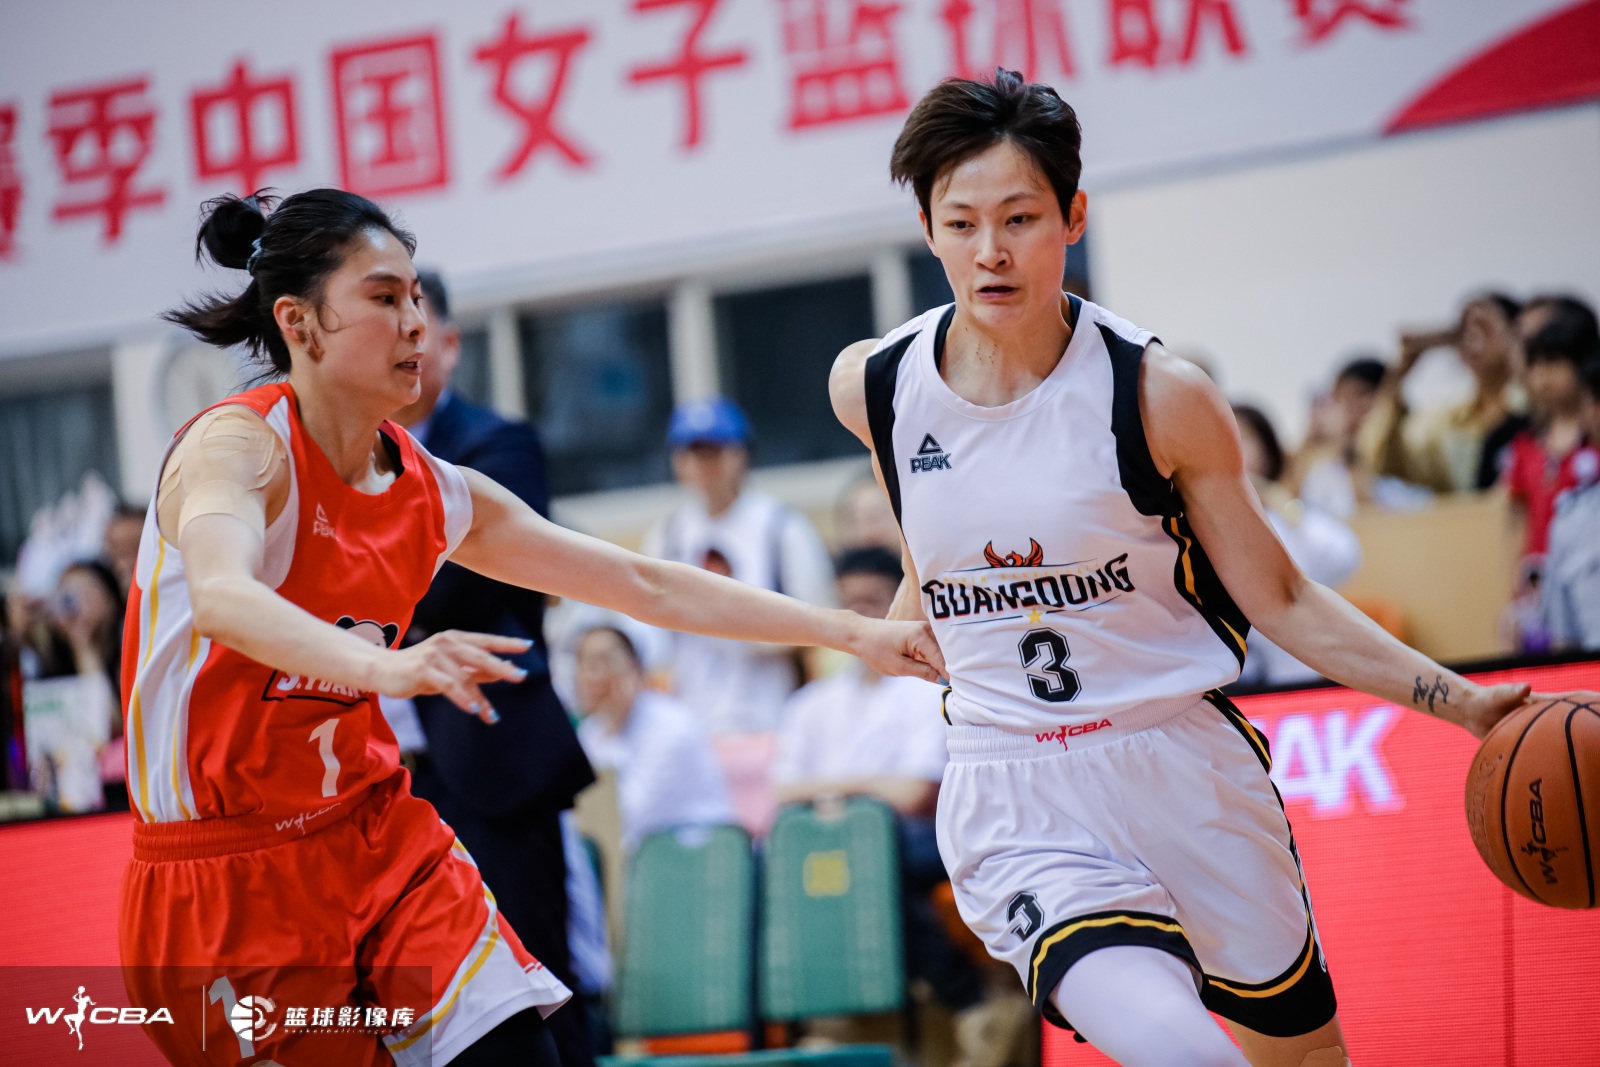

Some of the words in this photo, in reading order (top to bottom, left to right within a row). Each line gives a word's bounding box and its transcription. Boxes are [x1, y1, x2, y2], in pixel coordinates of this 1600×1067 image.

[0, 0, 1402, 258] 季中国女子篮球
[911, 453, 951, 473] PEAK
[922, 552, 1136, 620] GUANGDONG
[1018, 627, 1082, 703] 3
[308, 718, 340, 798] 1
[1035, 718, 1112, 744] WCBA
[1248, 704, 1402, 815] AK
[1529, 778, 1559, 885] WCBA
